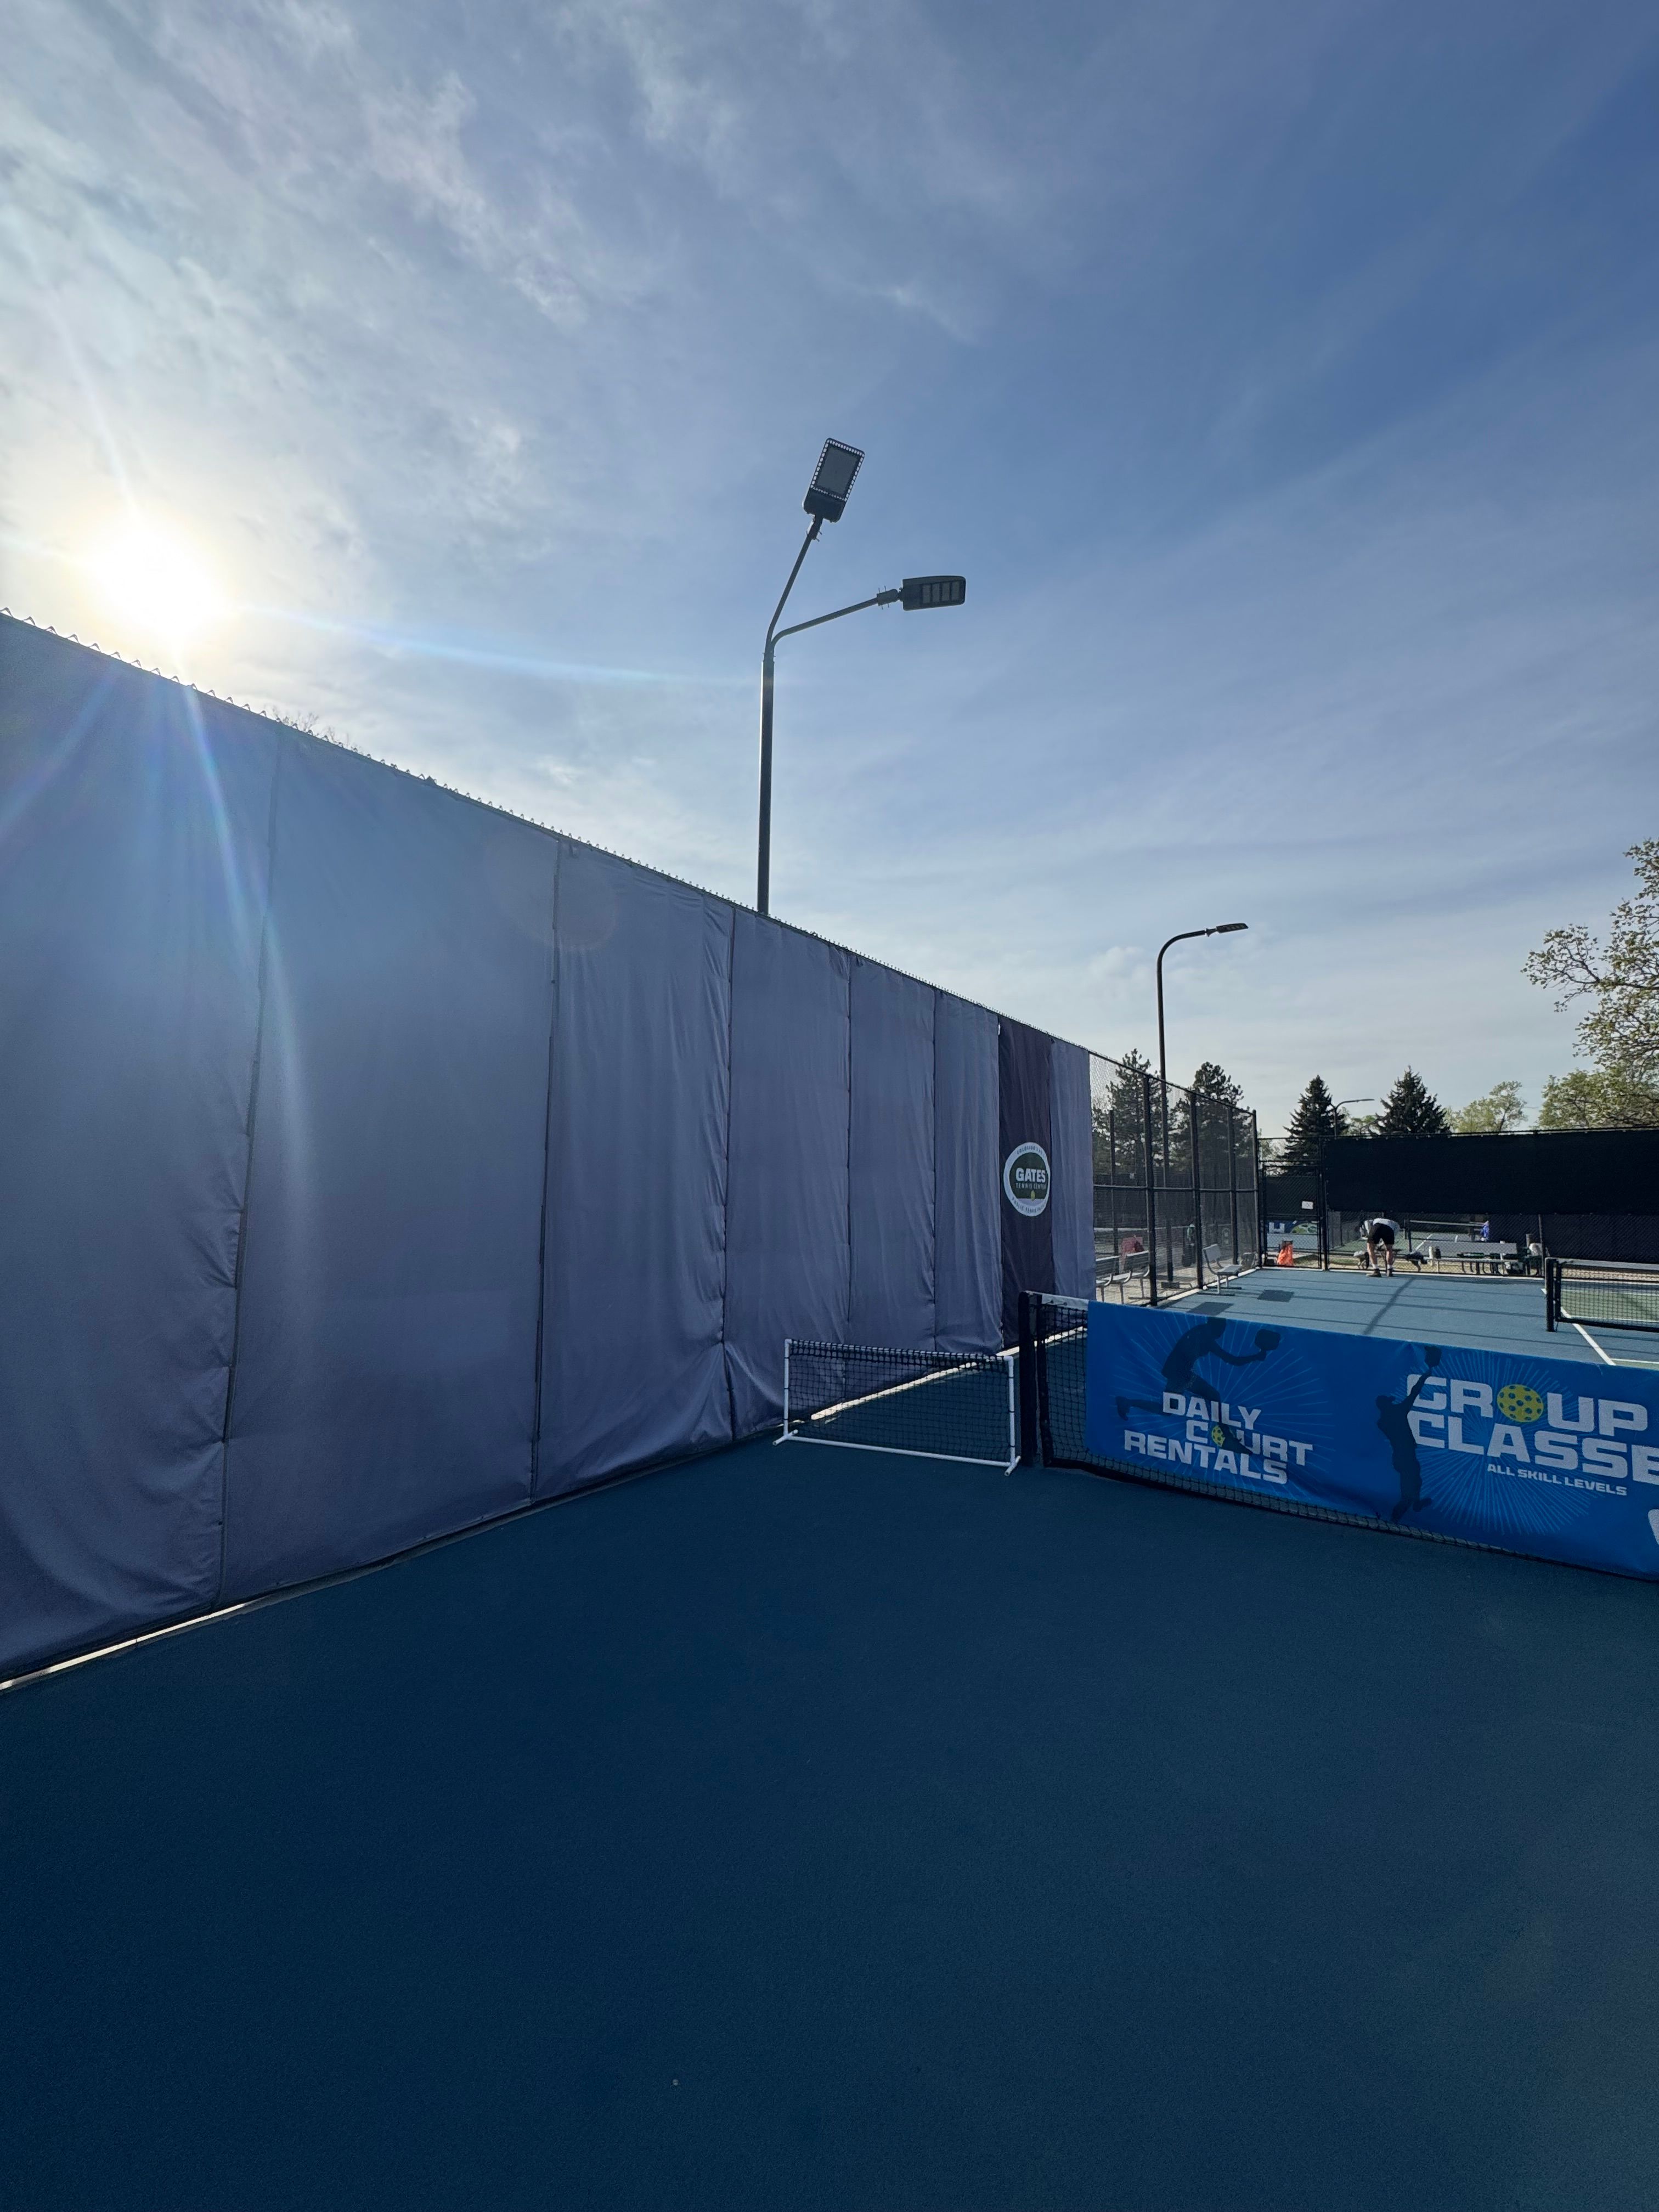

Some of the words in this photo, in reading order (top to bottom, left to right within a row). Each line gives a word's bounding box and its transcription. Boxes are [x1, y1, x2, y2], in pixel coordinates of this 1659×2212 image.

[1016, 1167, 1046, 1183] GATES
[1163, 1392, 1262, 1430] DAILY
[1407, 1374, 1648, 1436] GROUP
[1124, 1430, 1288, 1485] RENTALS
[1487, 1463, 1515, 1477] ALL
[1517, 1469, 1562, 1485] SKILL
[1564, 1477, 1628, 1496] LEVELS
